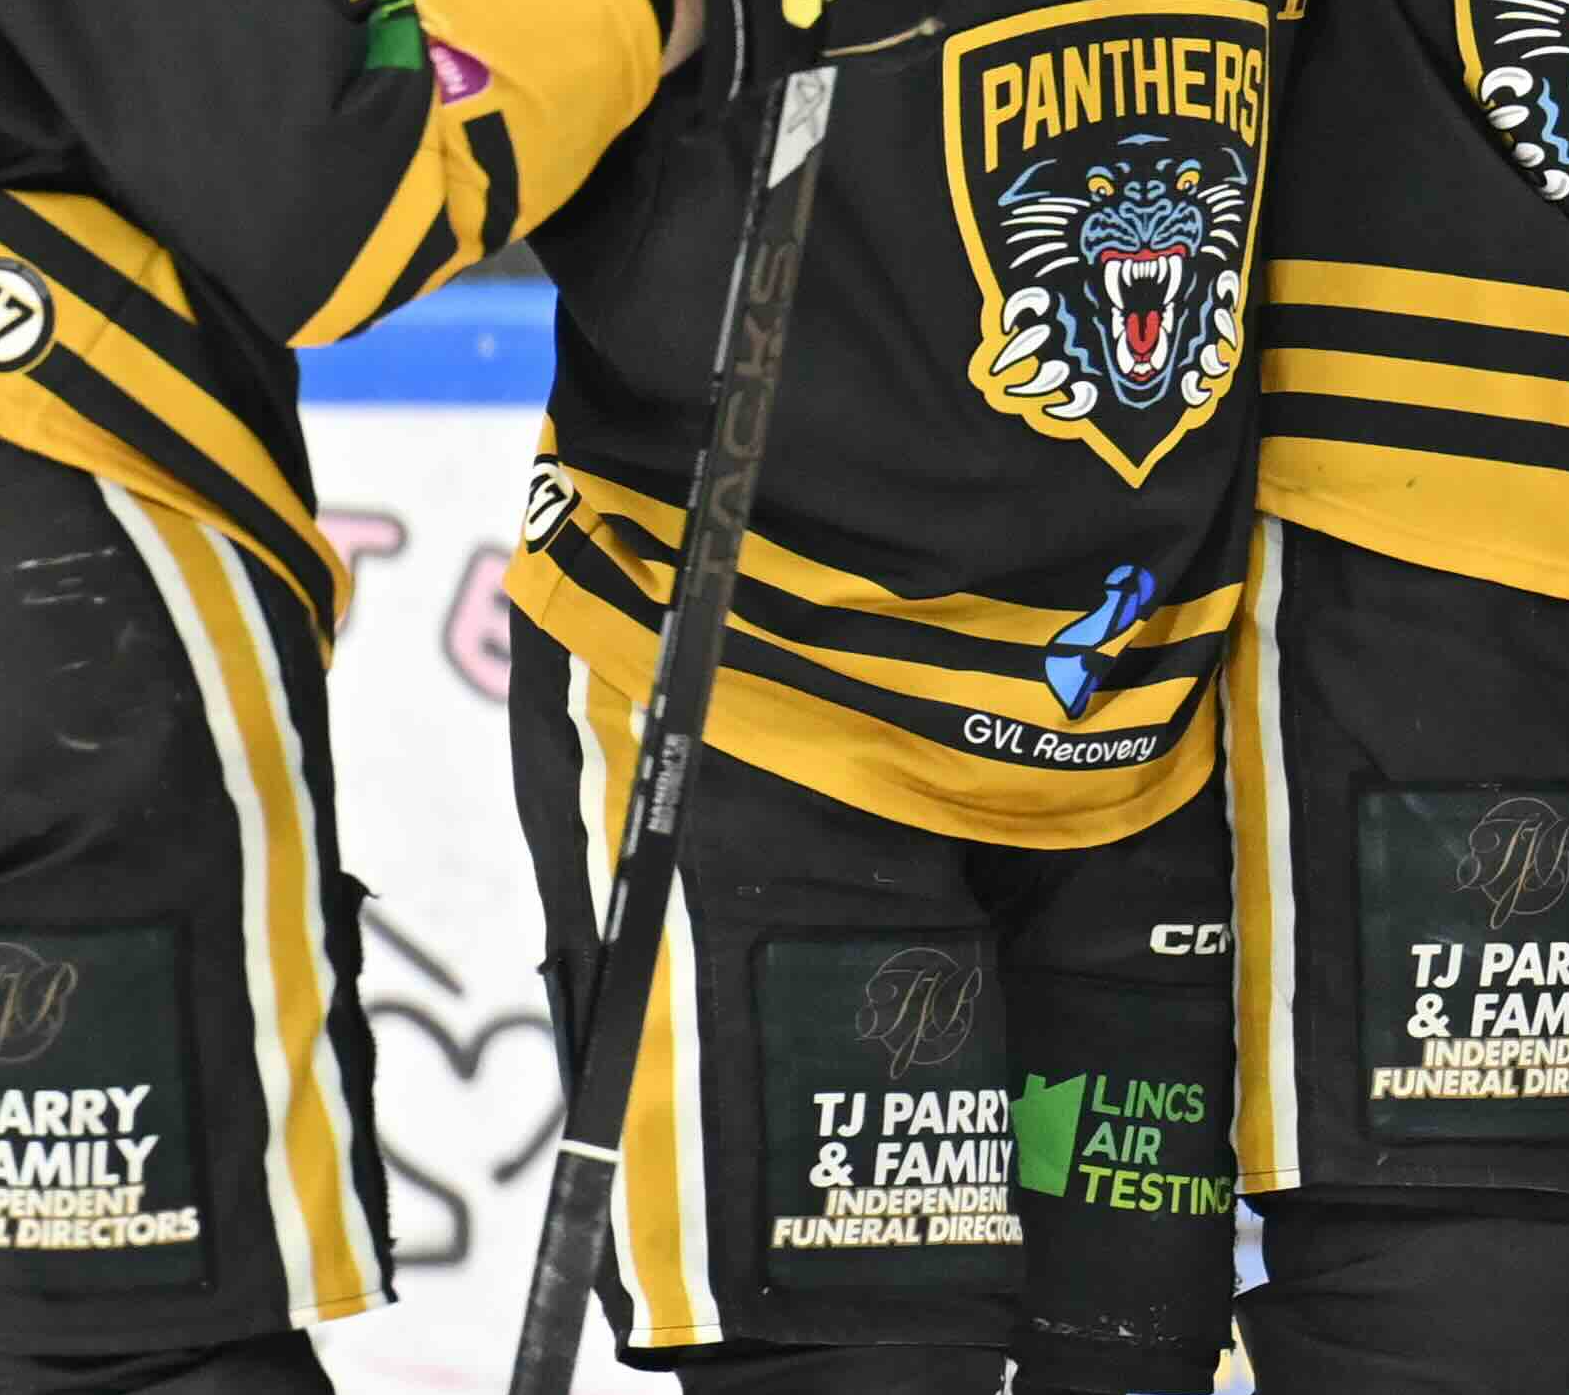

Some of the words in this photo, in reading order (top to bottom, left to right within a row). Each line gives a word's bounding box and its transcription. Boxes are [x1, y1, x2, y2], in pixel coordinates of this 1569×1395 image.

[981, 36, 1264, 174] PANTHERS
[962, 712, 1026, 757] GVL
[1033, 731, 1158, 766] Recovery
[1410, 942, 1464, 990] TJ
[1406, 992, 1451, 1040] &
[1090, 1073, 1206, 1125] LINCS
[1371, 1067, 1520, 1101] FUNERAL
[813, 1091, 867, 1139] TJ
[808, 1141, 856, 1190] &
[873, 1138, 1014, 1187] FAMILY
[1082, 1120, 1163, 1168] AIR
[13, 1205, 201, 1248] DIRECTORS
[771, 1215, 923, 1250] FUNERAL
